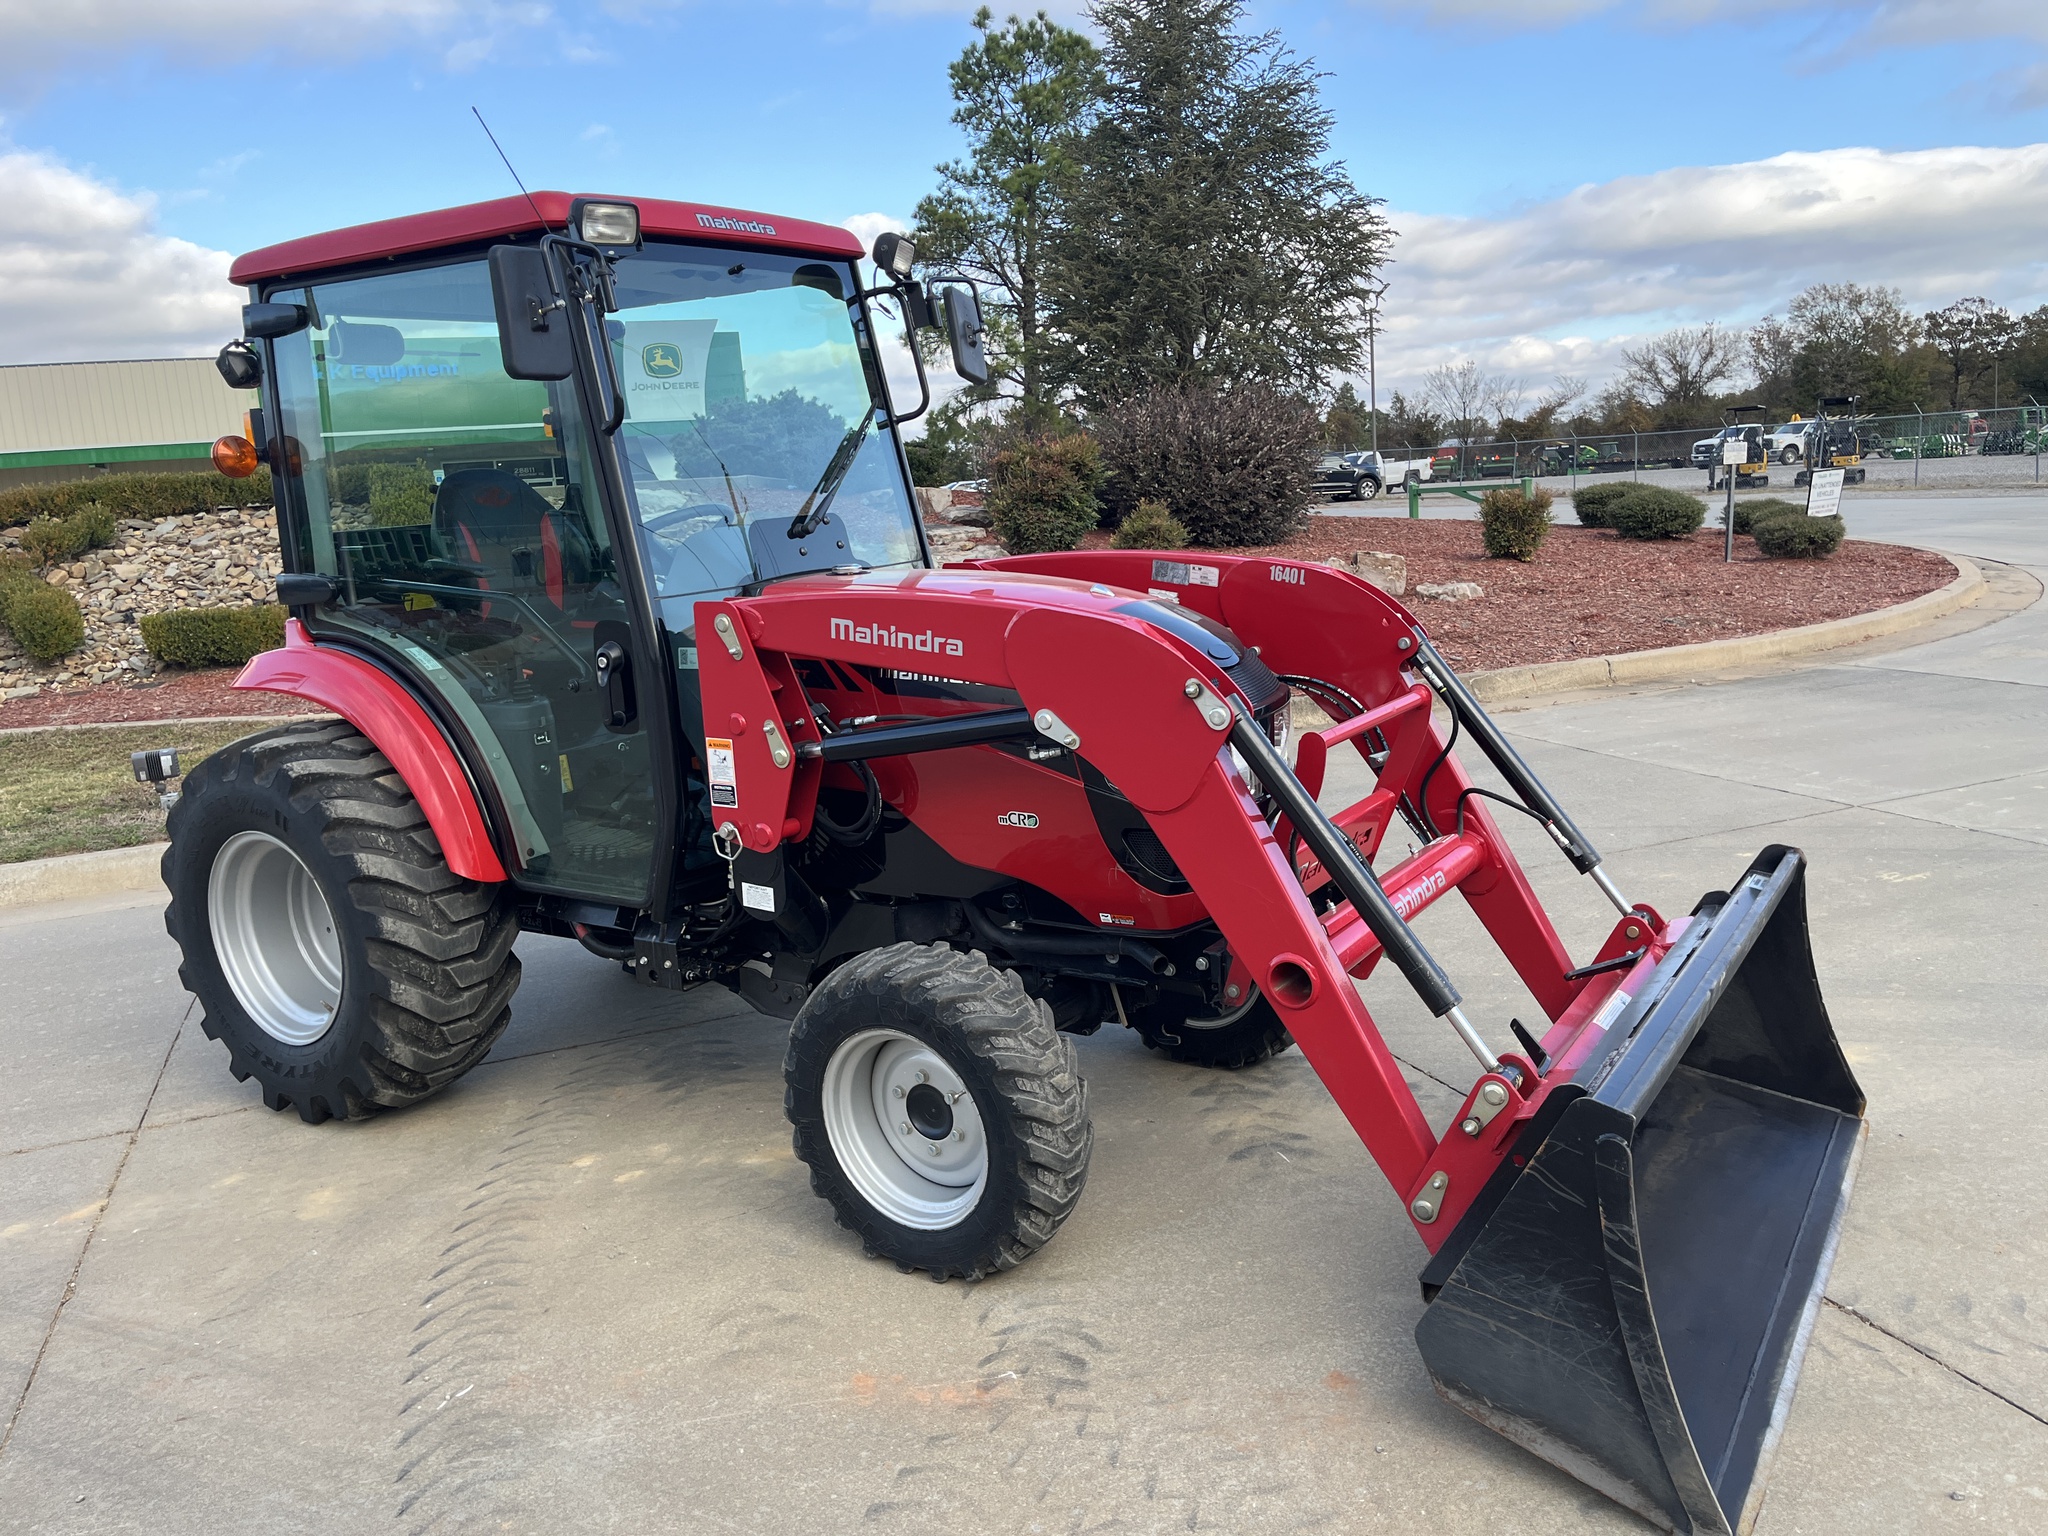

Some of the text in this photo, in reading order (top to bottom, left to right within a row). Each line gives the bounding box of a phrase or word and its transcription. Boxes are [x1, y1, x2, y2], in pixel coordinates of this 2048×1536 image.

[695, 213, 777, 236] Mahindra
[352, 363, 458, 382] Equipment
[632, 381, 699, 391] JOHN DEERE
[1269, 565, 1306, 585] 1640 L
[831, 617, 963, 656] Mahindra
[1394, 870, 1447, 918] ahindra
